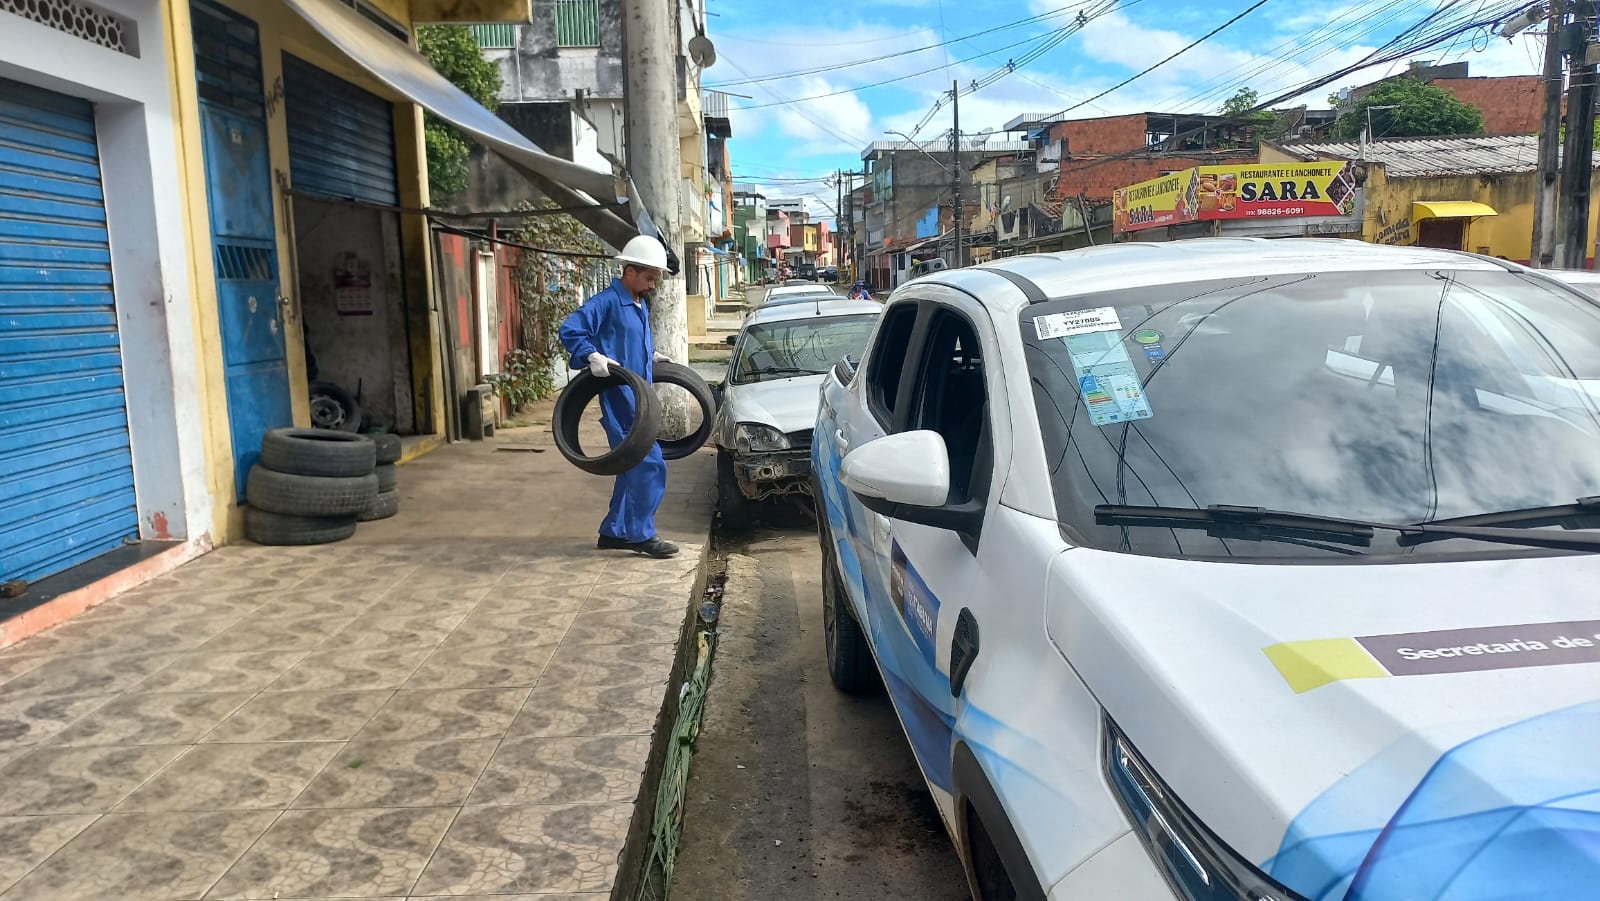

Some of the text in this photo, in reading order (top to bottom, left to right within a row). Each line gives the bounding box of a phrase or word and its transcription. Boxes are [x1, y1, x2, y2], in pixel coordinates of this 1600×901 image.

[1240, 167, 1332, 179] RESTAURANTE E LANCHONETE
[1241, 180, 1321, 202] SARA
[1129, 204, 1154, 225] SARA
[1257, 207, 1304, 216] 98826-6091
[1397, 639, 1550, 660] Secretaria
[1552, 636, 1595, 649] de
